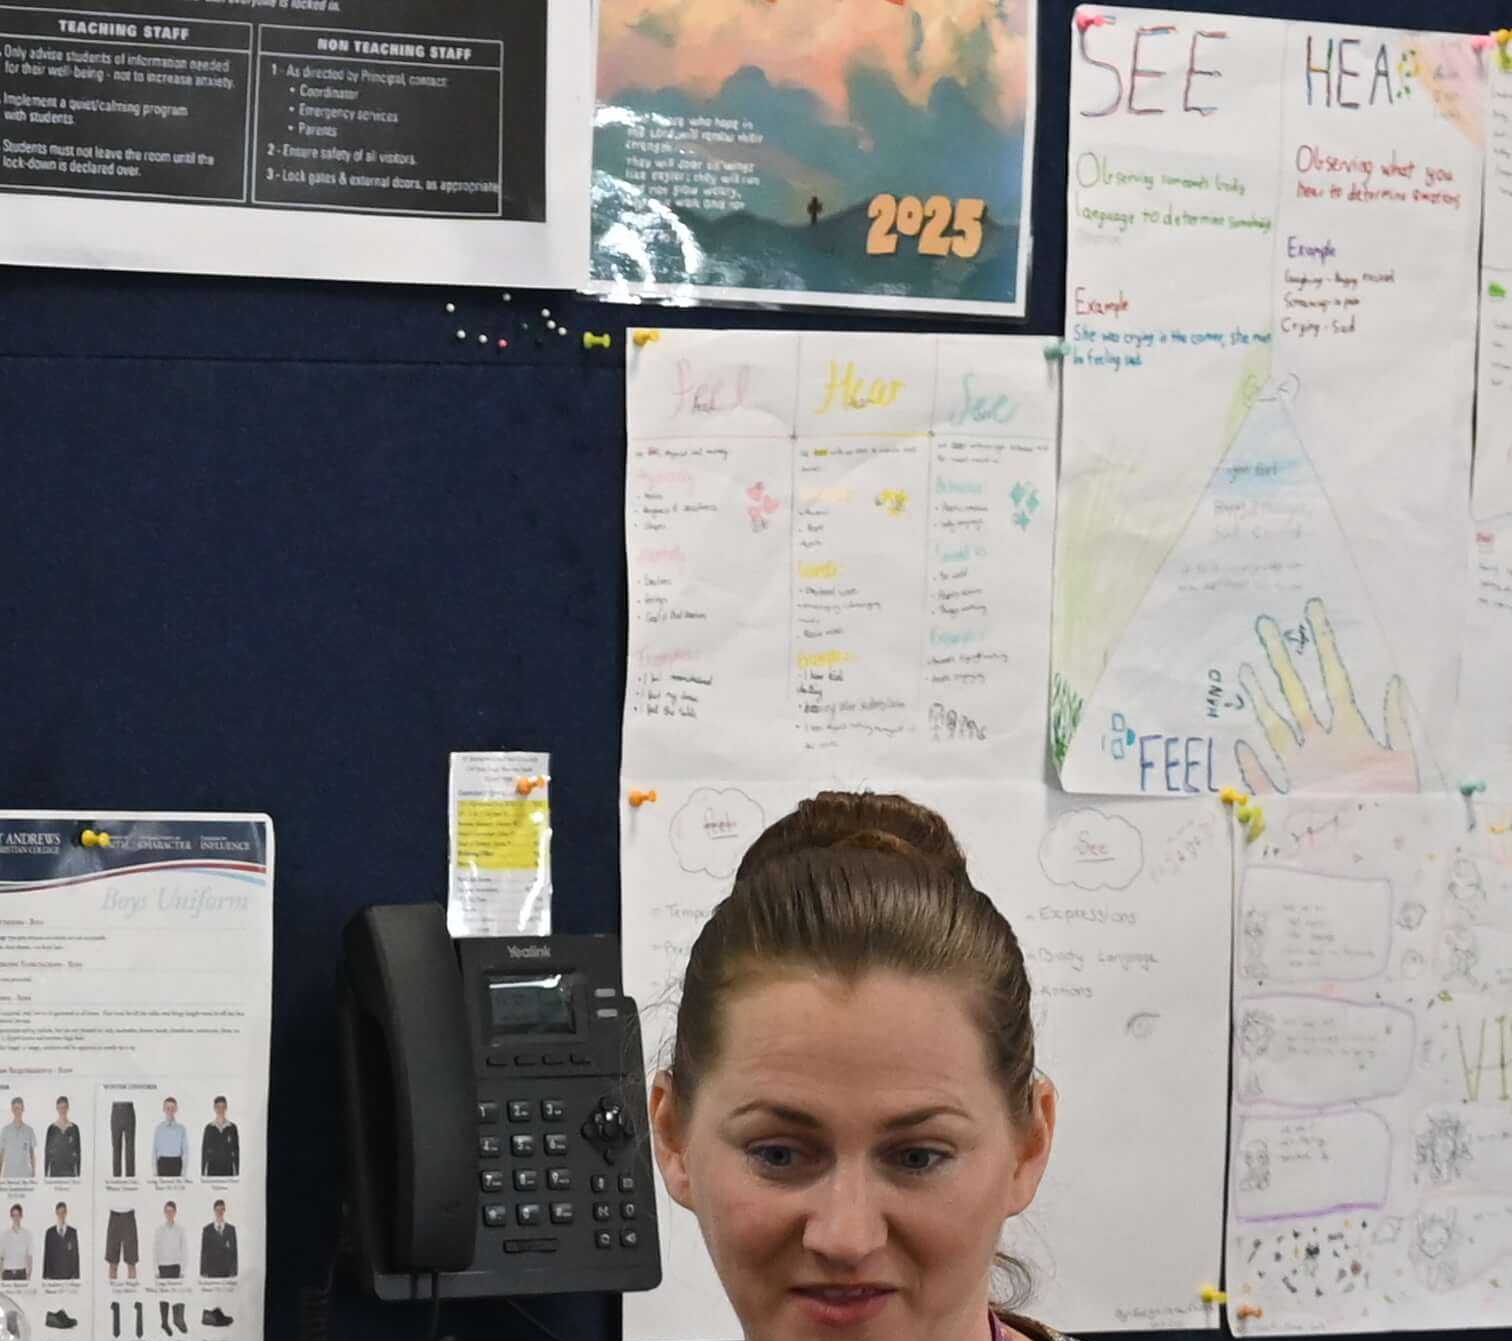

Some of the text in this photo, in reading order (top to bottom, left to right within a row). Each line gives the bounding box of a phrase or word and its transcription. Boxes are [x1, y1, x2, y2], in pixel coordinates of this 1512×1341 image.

[58, 19, 190, 41] TEACHING STAFF
[4, 44, 27, 62] Only
[29, 46, 64, 62] advise
[66, 48, 112, 65] students
[318, 38, 472, 61] NON TEACHING STAFF
[4, 62, 20, 75] for
[22, 63, 46, 77] their
[134, 69, 144, 83] to
[146, 71, 194, 87] increase
[286, 64, 301, 78] As
[1078, 18, 1228, 118] SEE
[3, 92, 58, 109] Implement
[142, 103, 189, 120] program
[4, 109, 26, 122] with
[299, 103, 356, 122] Emergency
[298, 122, 338, 138] Parents
[3, 140, 48, 154] Students
[50, 144, 74, 156] must
[76, 144, 92, 158] not
[94, 144, 124, 160] leave
[125, 147, 142, 160] the
[144, 151, 171, 164] room
[198, 152, 214, 166] the
[283, 144, 320, 160] Ensure
[282, 169, 306, 184] Lock
[866, 194, 986, 258] 2025
[1138, 734, 1221, 793] FEEL
[7, 832, 61, 846] ANDREWS
[157, 888, 249, 919] Uniform
[506, 945, 551, 959] Yealink
